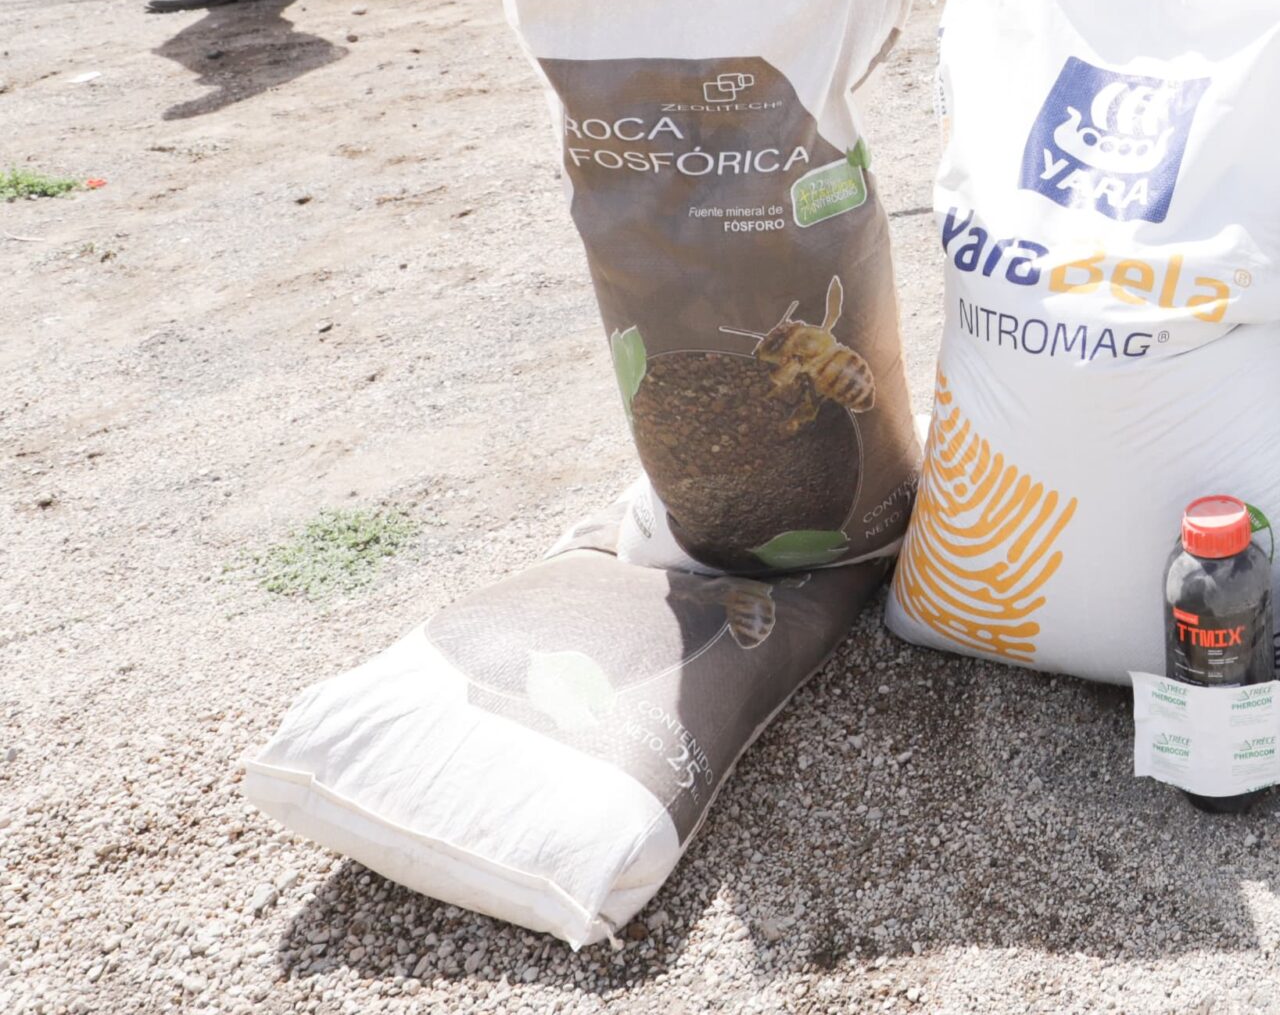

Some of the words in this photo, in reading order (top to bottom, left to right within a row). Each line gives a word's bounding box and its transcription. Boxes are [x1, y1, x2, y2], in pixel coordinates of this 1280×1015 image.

[565, 115, 684, 141] ROCA
[569, 145, 810, 176] FOSFÓRICA
[1040, 148, 1149, 209] YARA
[688, 206, 723, 219] Fuente
[725, 205, 764, 218] mineral
[766, 204, 783, 217] de
[724, 217, 785, 233] FÓSFORO
[1231, 697, 1273, 711] PHEROCON
[638, 701, 714, 785] CONTENIDO
[1152, 744, 1189, 757] PHEROCON
[1233, 749, 1275, 761] PHEROCON
[667, 744, 701, 788] 25
